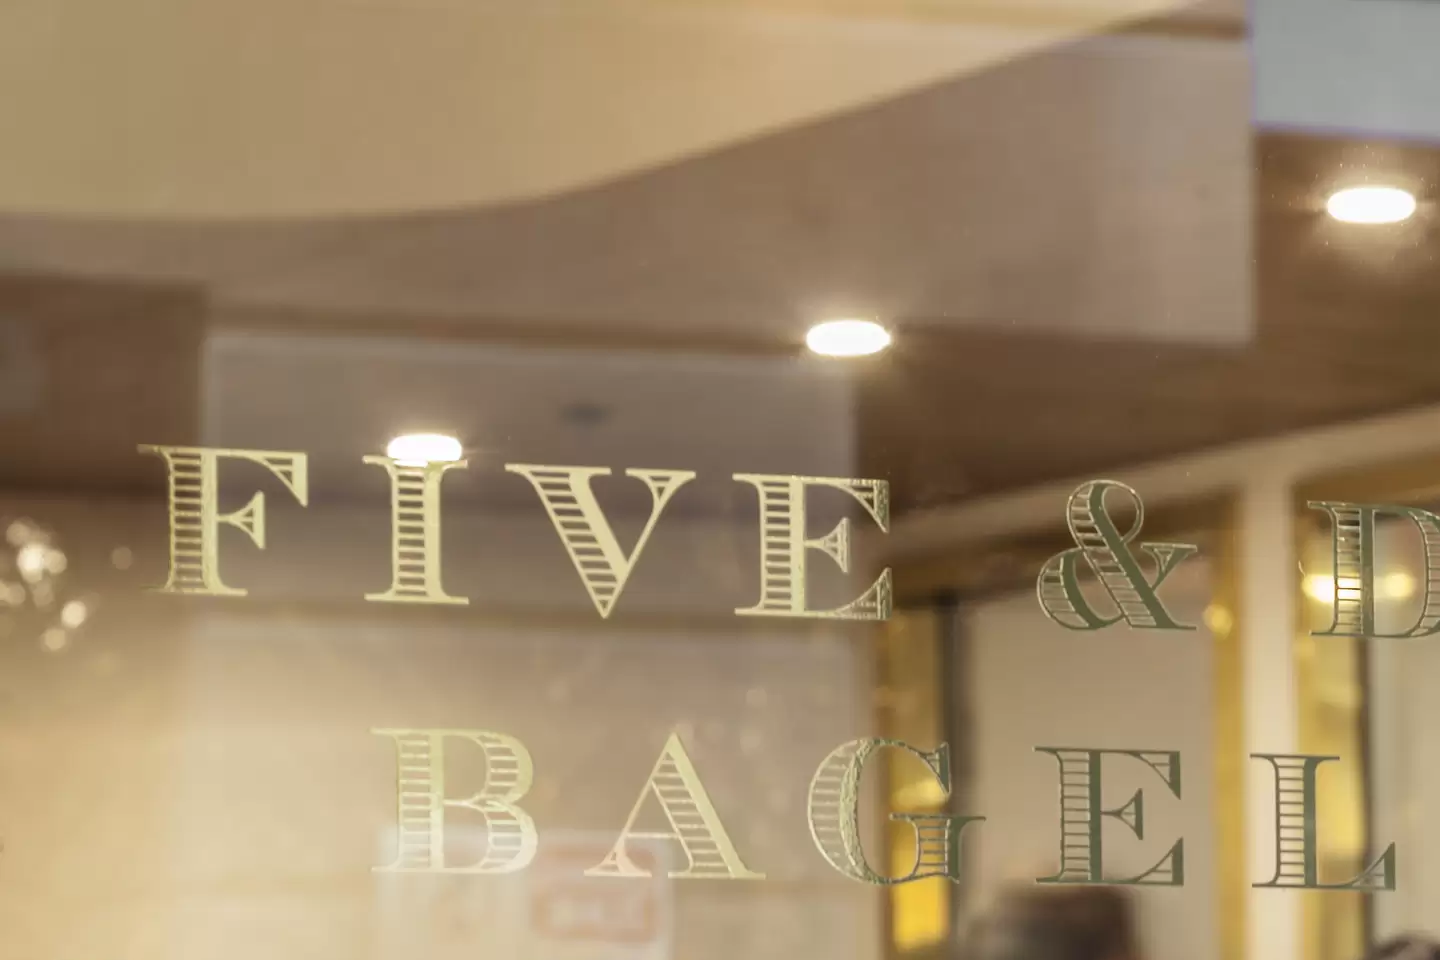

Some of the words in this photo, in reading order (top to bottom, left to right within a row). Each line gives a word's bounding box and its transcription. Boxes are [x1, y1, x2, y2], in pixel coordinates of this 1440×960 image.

[138, 444, 893, 621] FIVE
[1037, 479, 1197, 630] &
[371, 727, 1395, 891] BAGEL
